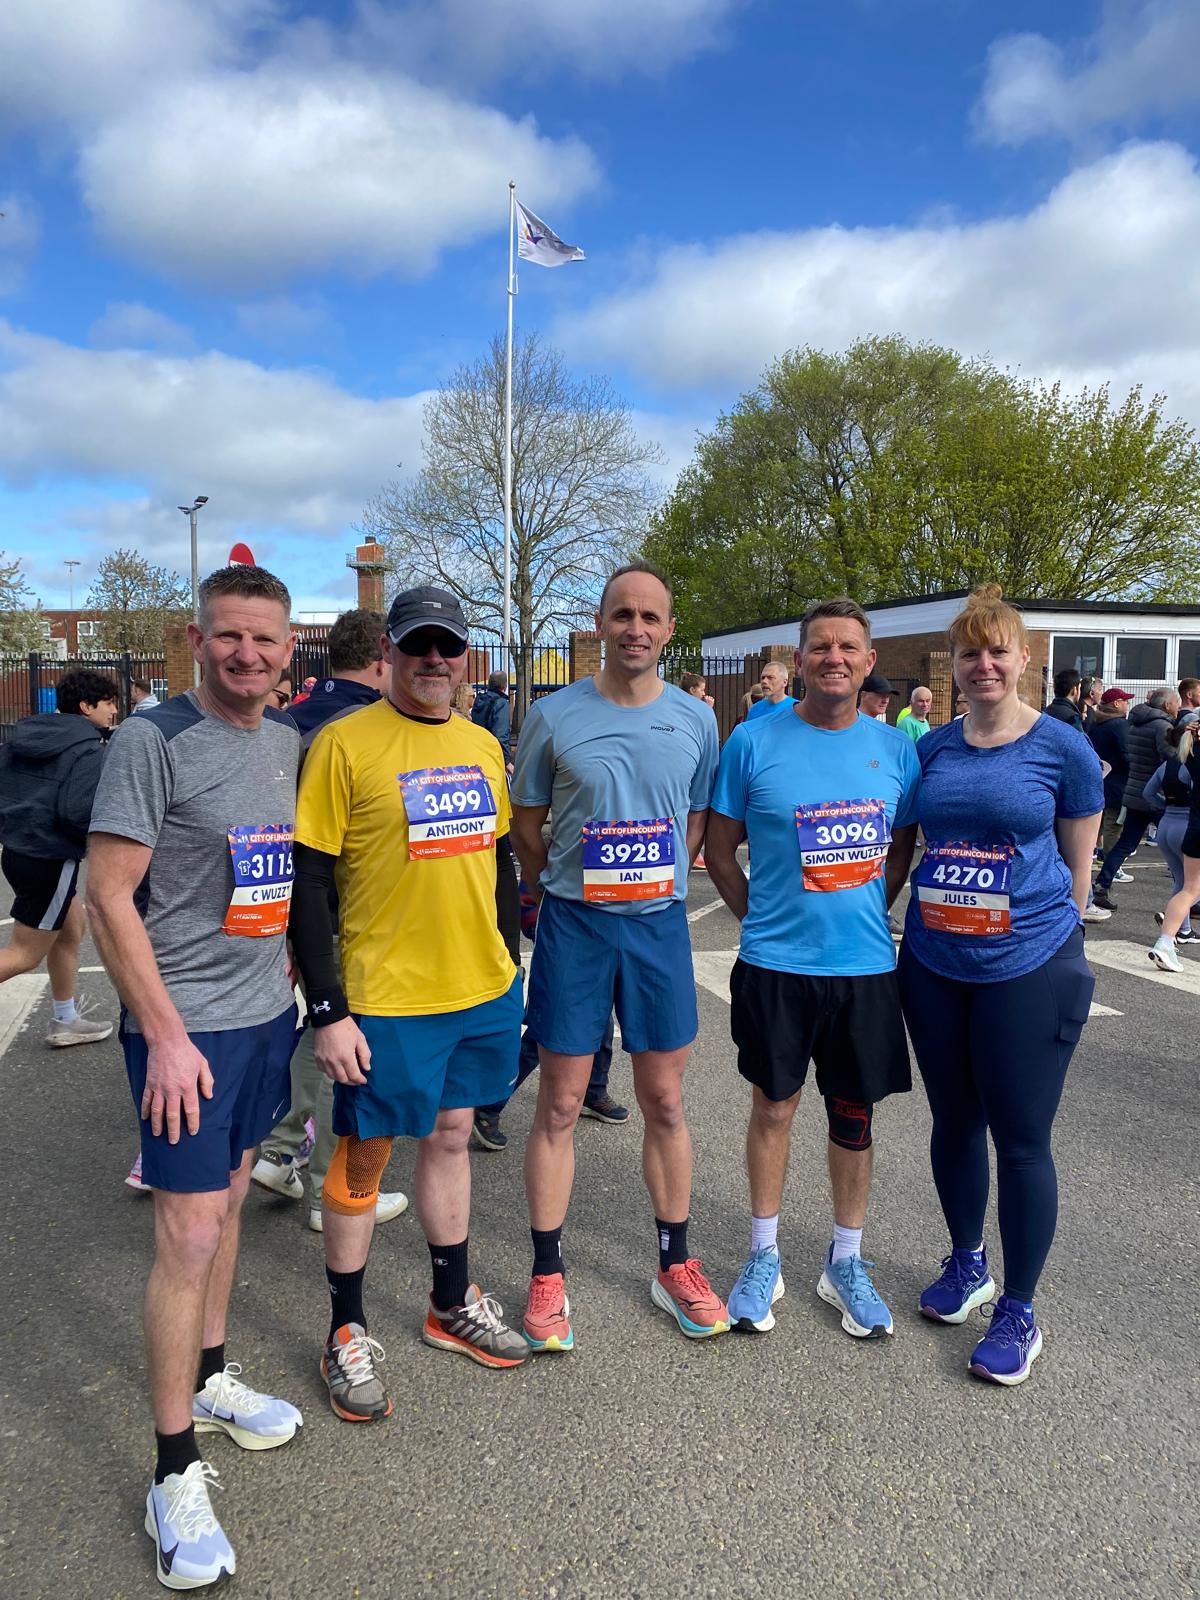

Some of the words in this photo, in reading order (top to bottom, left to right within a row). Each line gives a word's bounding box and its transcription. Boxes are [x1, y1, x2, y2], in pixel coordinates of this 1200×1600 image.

[421, 776, 435, 784] CITY
[444, 773, 472, 782] LINCOLN
[424, 789, 481, 816] 3499
[840, 805, 870, 814] LINCOLN
[426, 821, 485, 838] ANTHONY
[627, 826, 657, 834] LINCOLN
[816, 822, 878, 845] 3096
[250, 834, 265, 842] CITY
[600, 842, 661, 864] 3928
[805, 852, 845, 865] SIMON
[848, 845, 887, 861] WUZZY
[960, 850, 992, 859] LINCOLN
[992, 853, 1007, 861] 10K
[620, 871, 643, 882] IAN
[932, 864, 995, 888] 4270
[251, 890, 258, 902] C
[942, 893, 977, 906] JULES
